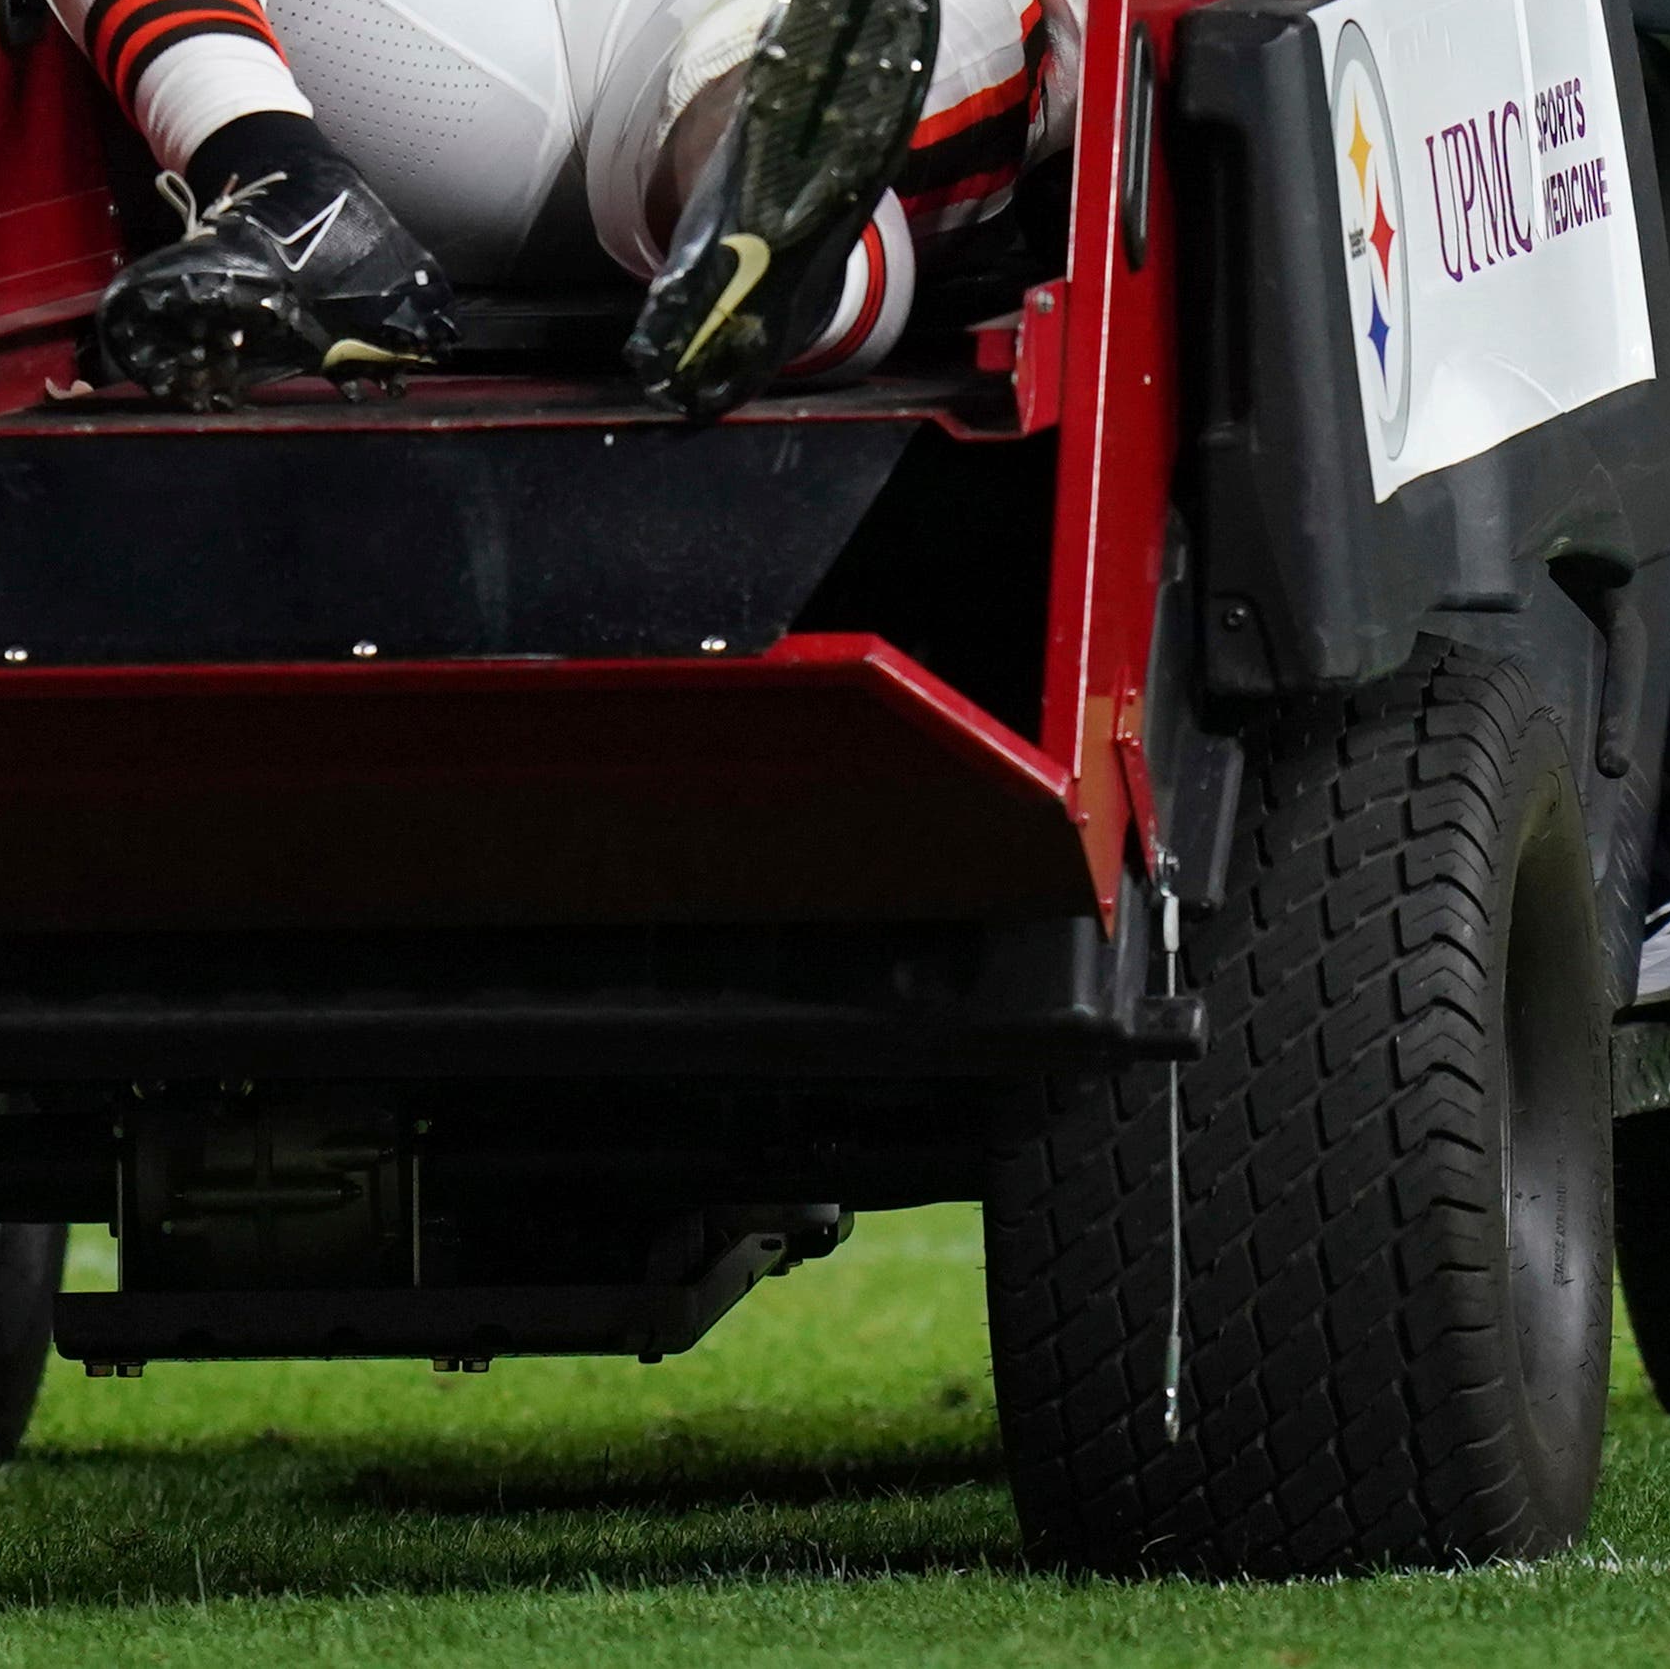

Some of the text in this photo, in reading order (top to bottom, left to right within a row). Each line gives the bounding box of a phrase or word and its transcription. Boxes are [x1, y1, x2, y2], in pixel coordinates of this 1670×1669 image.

[1535, 78, 1586, 154] SPORTS
[1426, 101, 1533, 282] UPMC
[1541, 157, 1612, 241] MEDICINE
